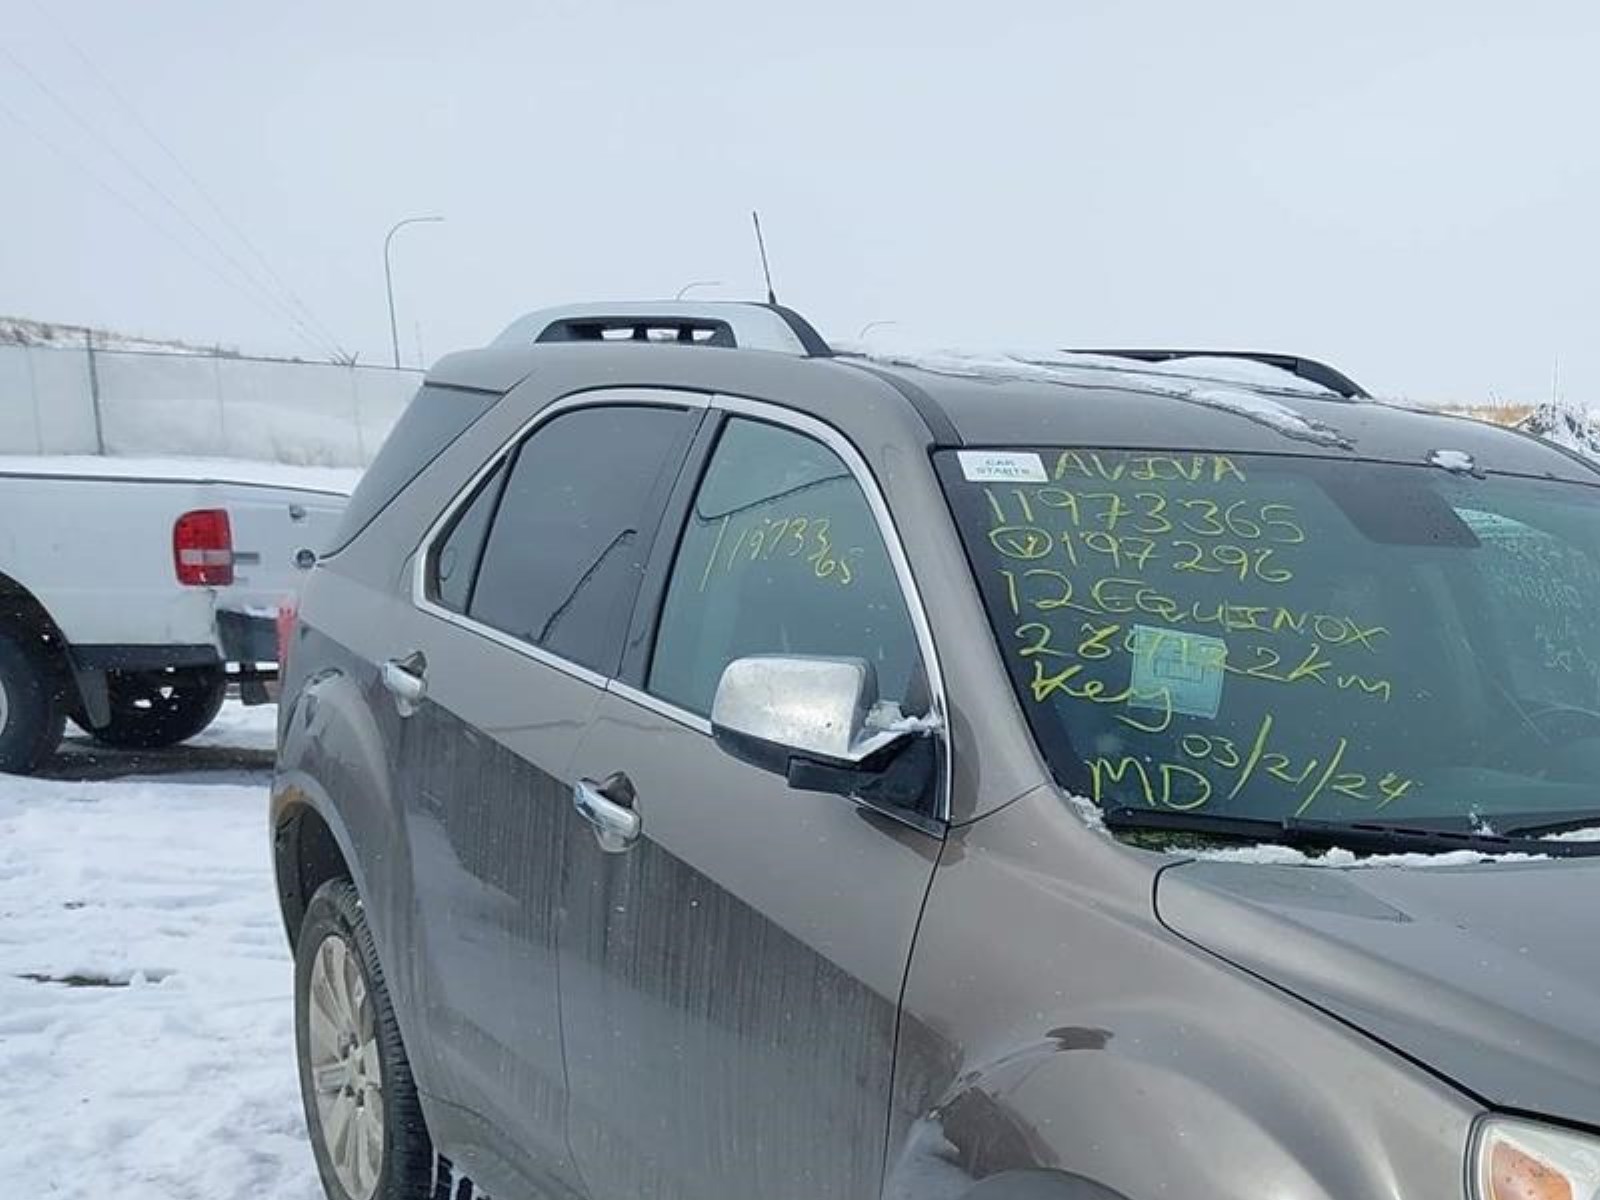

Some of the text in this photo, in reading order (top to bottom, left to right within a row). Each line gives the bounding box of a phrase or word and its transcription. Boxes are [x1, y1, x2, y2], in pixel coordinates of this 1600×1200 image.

[1054, 450, 1246, 482] AVIVA
[984, 488, 1305, 545] 11973365
[699, 514, 864, 593] 11973365
[1032, 659, 1173, 733] Key
[1084, 756, 1211, 810] MD
[1182, 713, 1412, 818] 03/21/24
